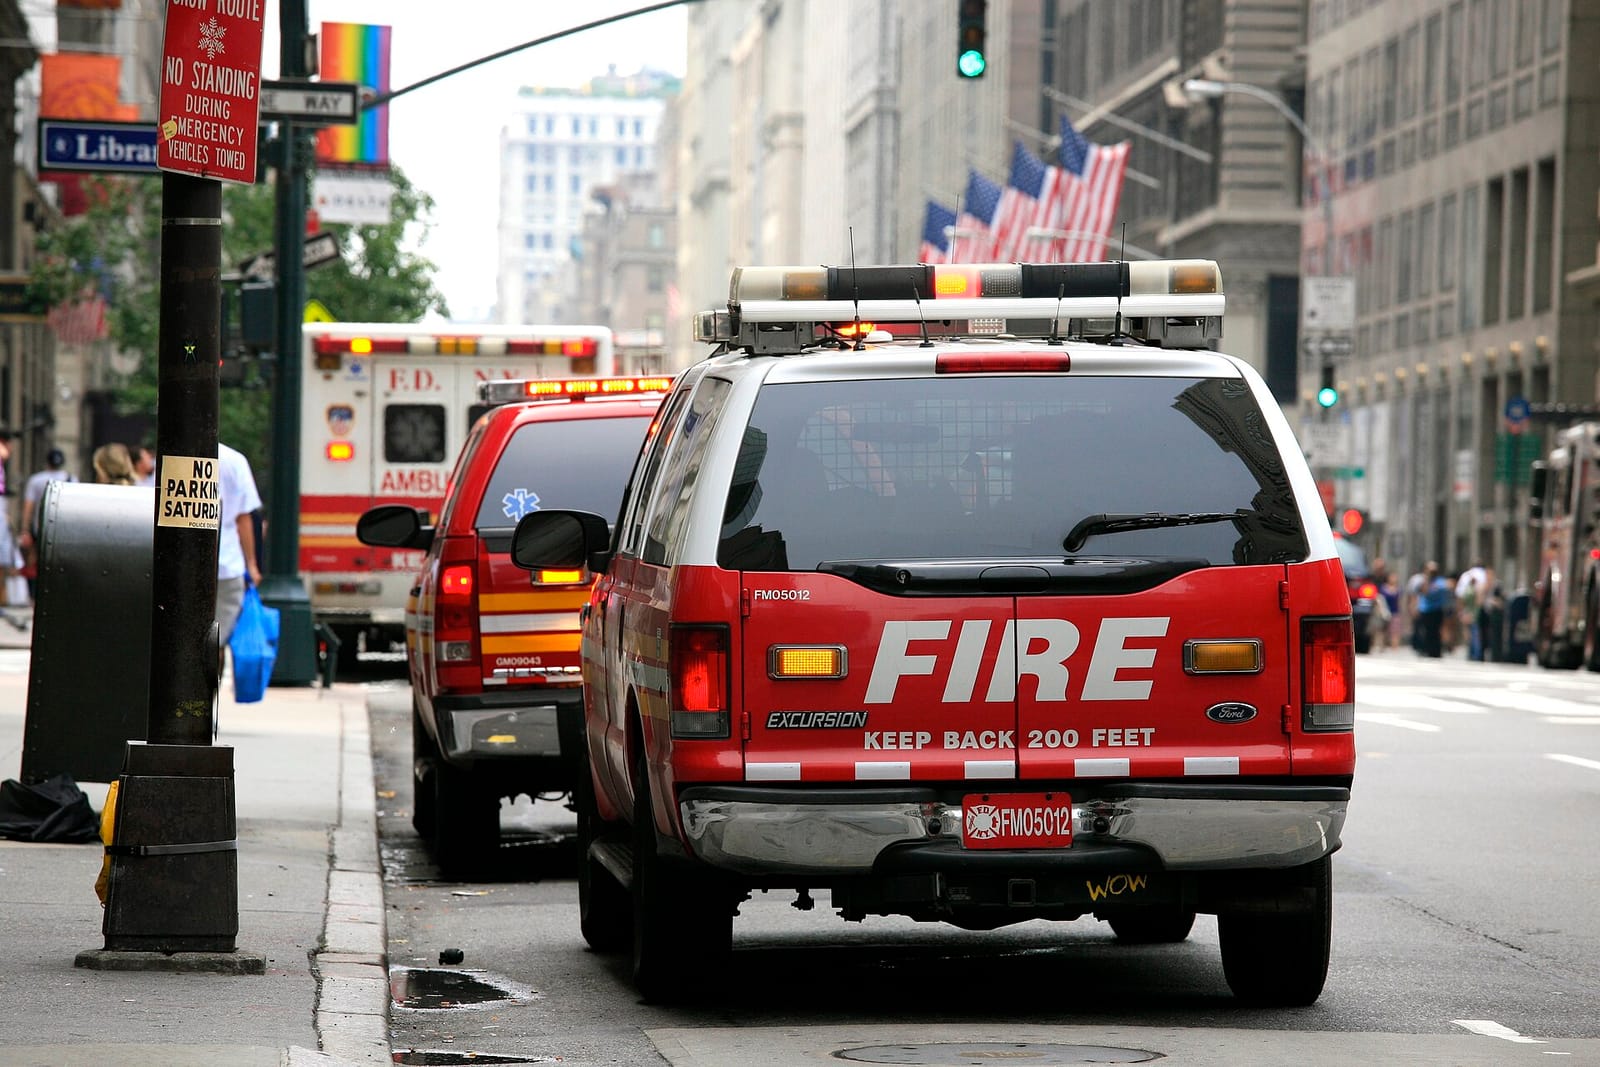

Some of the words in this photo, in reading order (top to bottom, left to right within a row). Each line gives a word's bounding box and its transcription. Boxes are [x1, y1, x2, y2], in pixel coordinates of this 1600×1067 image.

[166, 56, 184, 87] NO
[191, 61, 256, 100] STANDING
[185, 93, 232, 120] DURING
[302, 94, 342, 111] WAY
[168, 139, 209, 165] VEHICLES
[215, 147, 246, 171] TOWED
[389, 368, 442, 391] F.D.
[193, 460, 213, 479] NO
[863, 616, 1171, 704] FIRE
[766, 711, 868, 729] EXCURSION
[1218, 706, 1245, 718] Ford
[863, 731, 932, 750] KEEP
[943, 730, 1016, 749] BACK
[1027, 729, 1079, 748] 200
[1091, 727, 1156, 747] FEET
[1001, 806, 1070, 836] FM05012
[1086, 874, 1148, 902] WOW
